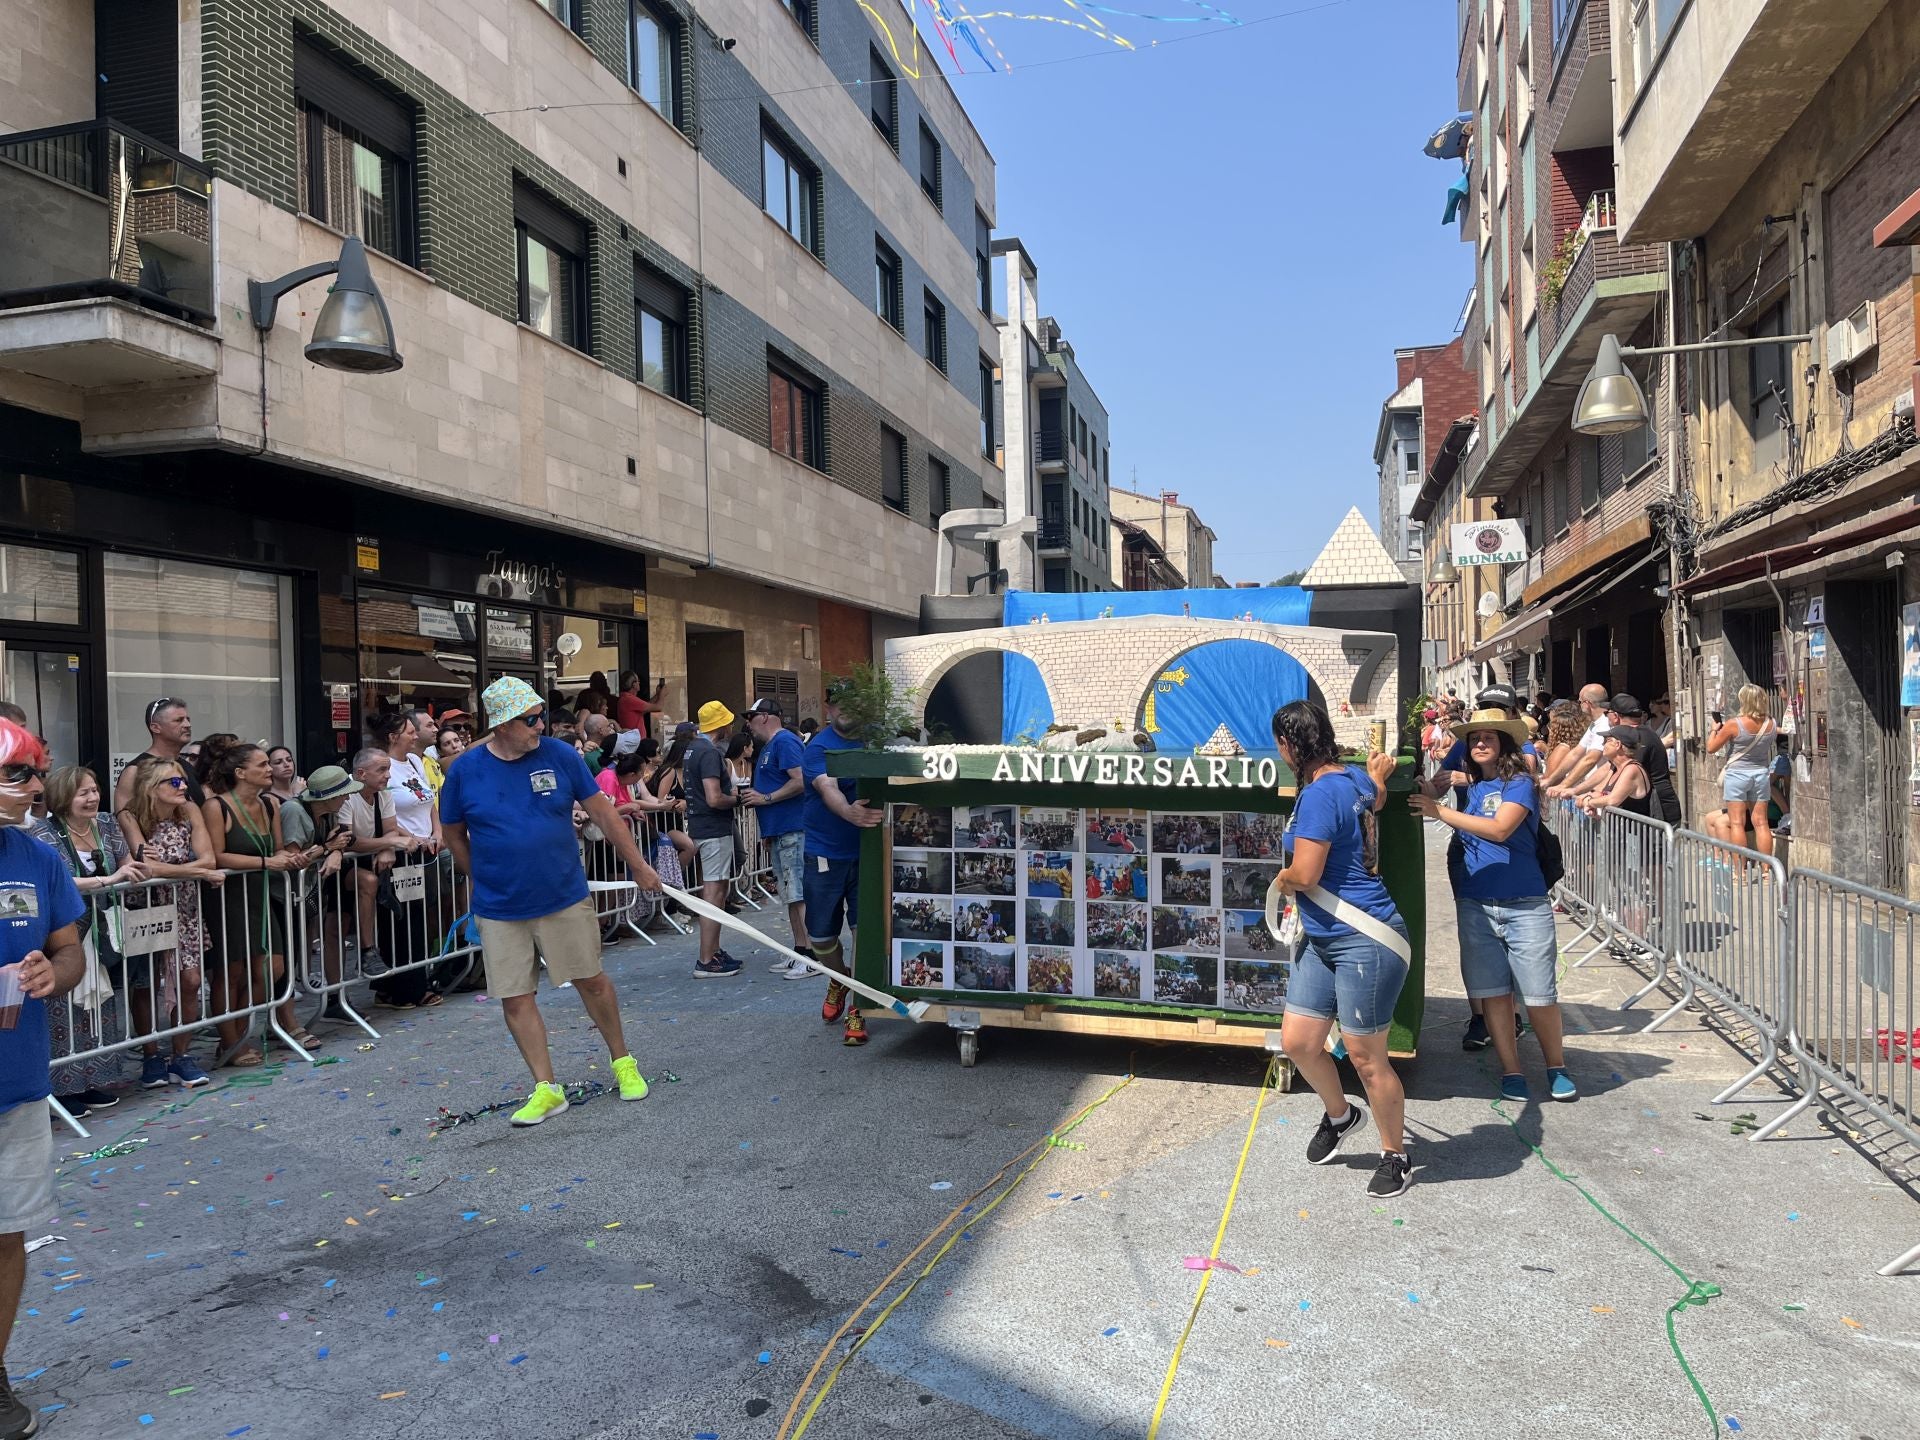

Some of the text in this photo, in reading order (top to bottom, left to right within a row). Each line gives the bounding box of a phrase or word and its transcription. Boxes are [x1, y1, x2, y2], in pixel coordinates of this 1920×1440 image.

[486, 549, 563, 595] Tanga's
[1457, 551, 1522, 565] BUNKAI
[1341, 634, 1396, 704] 7
[1482, 688, 1510, 698] adidas
[922, 751, 1277, 788] 30 ANIVERSARIO
